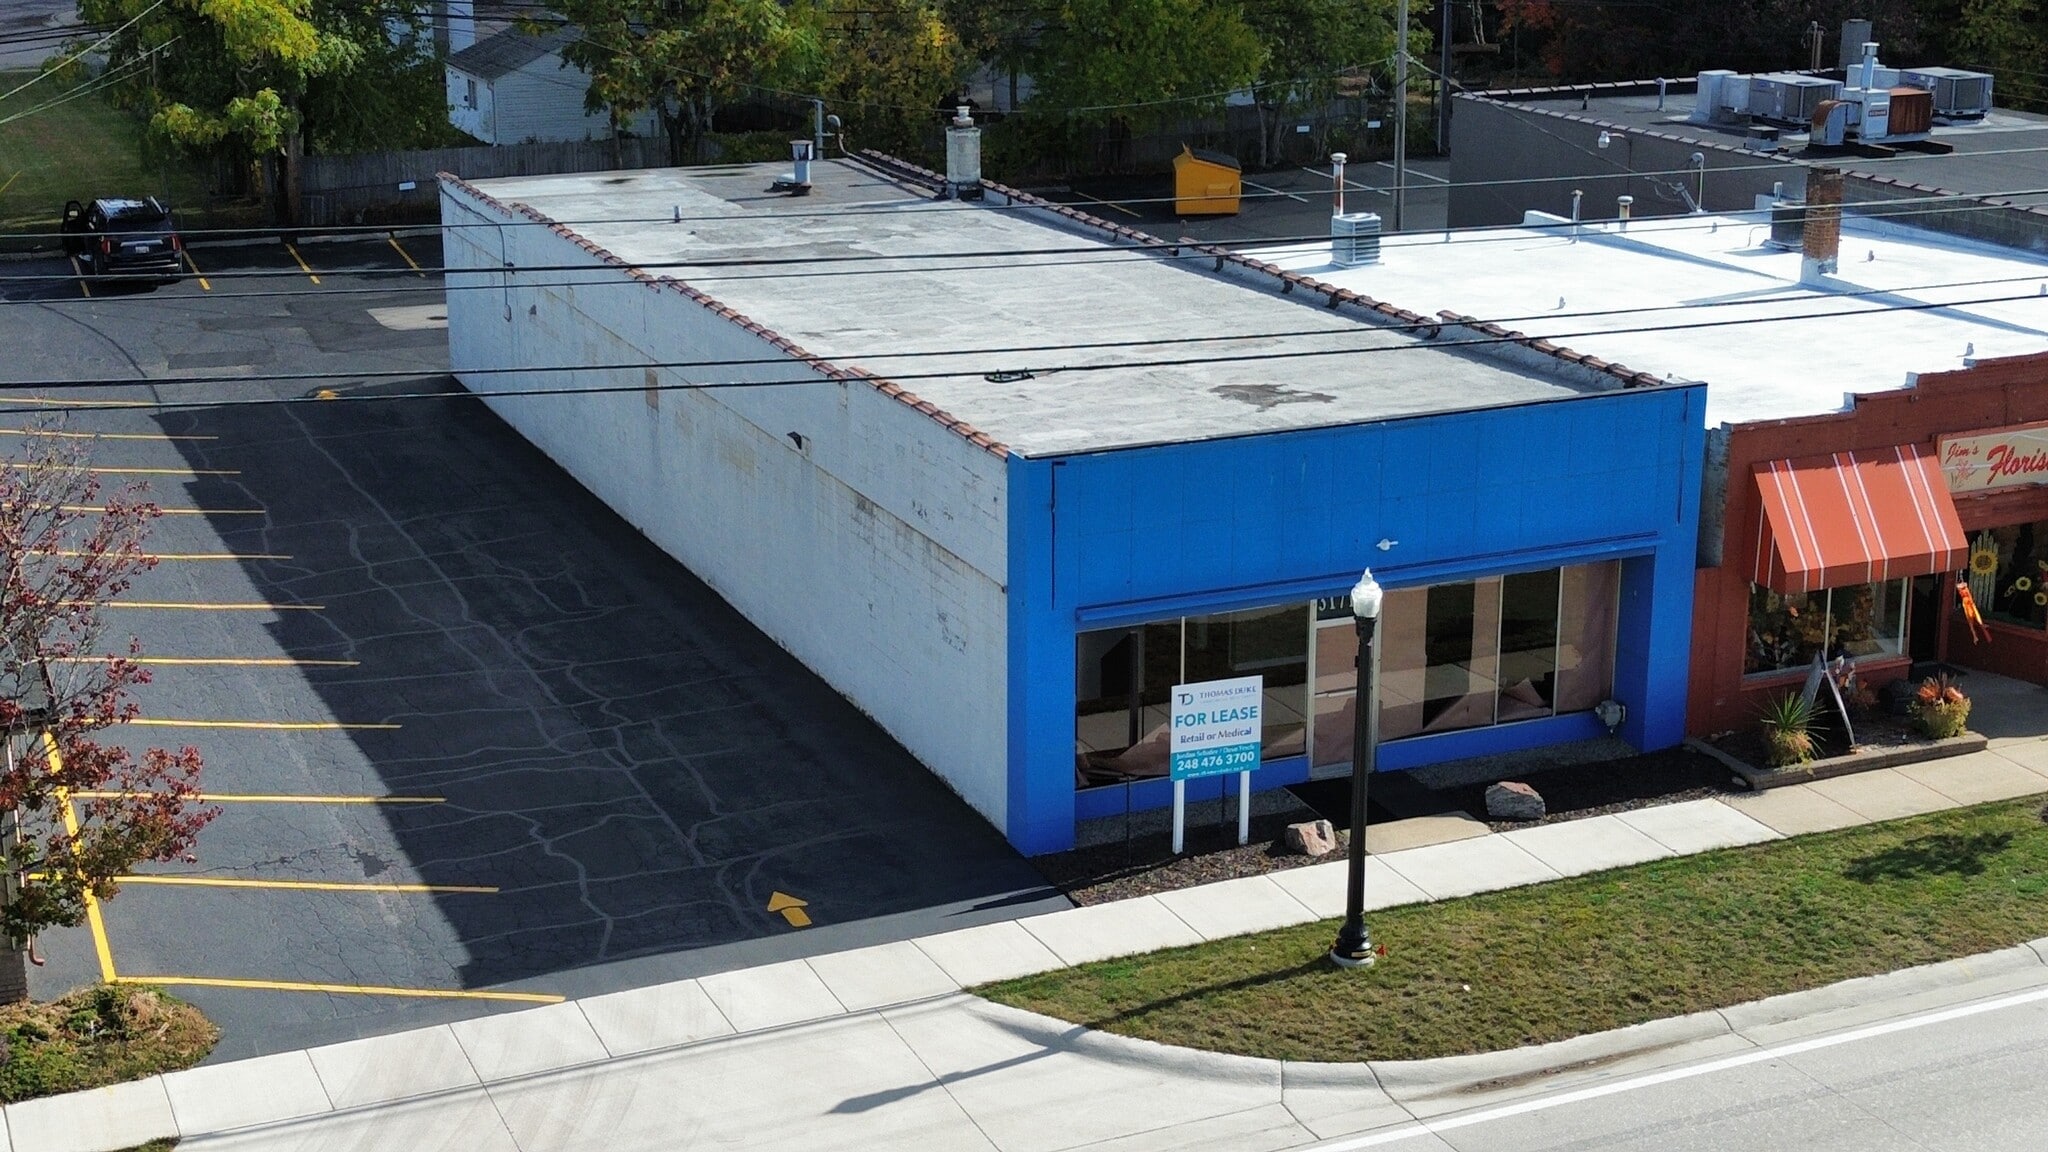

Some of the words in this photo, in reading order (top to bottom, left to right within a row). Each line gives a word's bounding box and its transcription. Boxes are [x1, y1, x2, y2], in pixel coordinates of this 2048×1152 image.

[1945, 441, 1979, 464] Jim's
[1987, 444, 2048, 485] Floris
[1200, 688, 1233, 699] THOMAS
[1234, 685, 1257, 694] DUKE
[1175, 712, 1207, 728] FOR
[1211, 706, 1258, 723] LEASE
[1180, 732, 1204, 744] Retail
[1218, 727, 1252, 739] Medical
[1177, 758, 1199, 771] 248
[1201, 755, 1223, 767] 476
[1226, 751, 1255, 764] 3700
